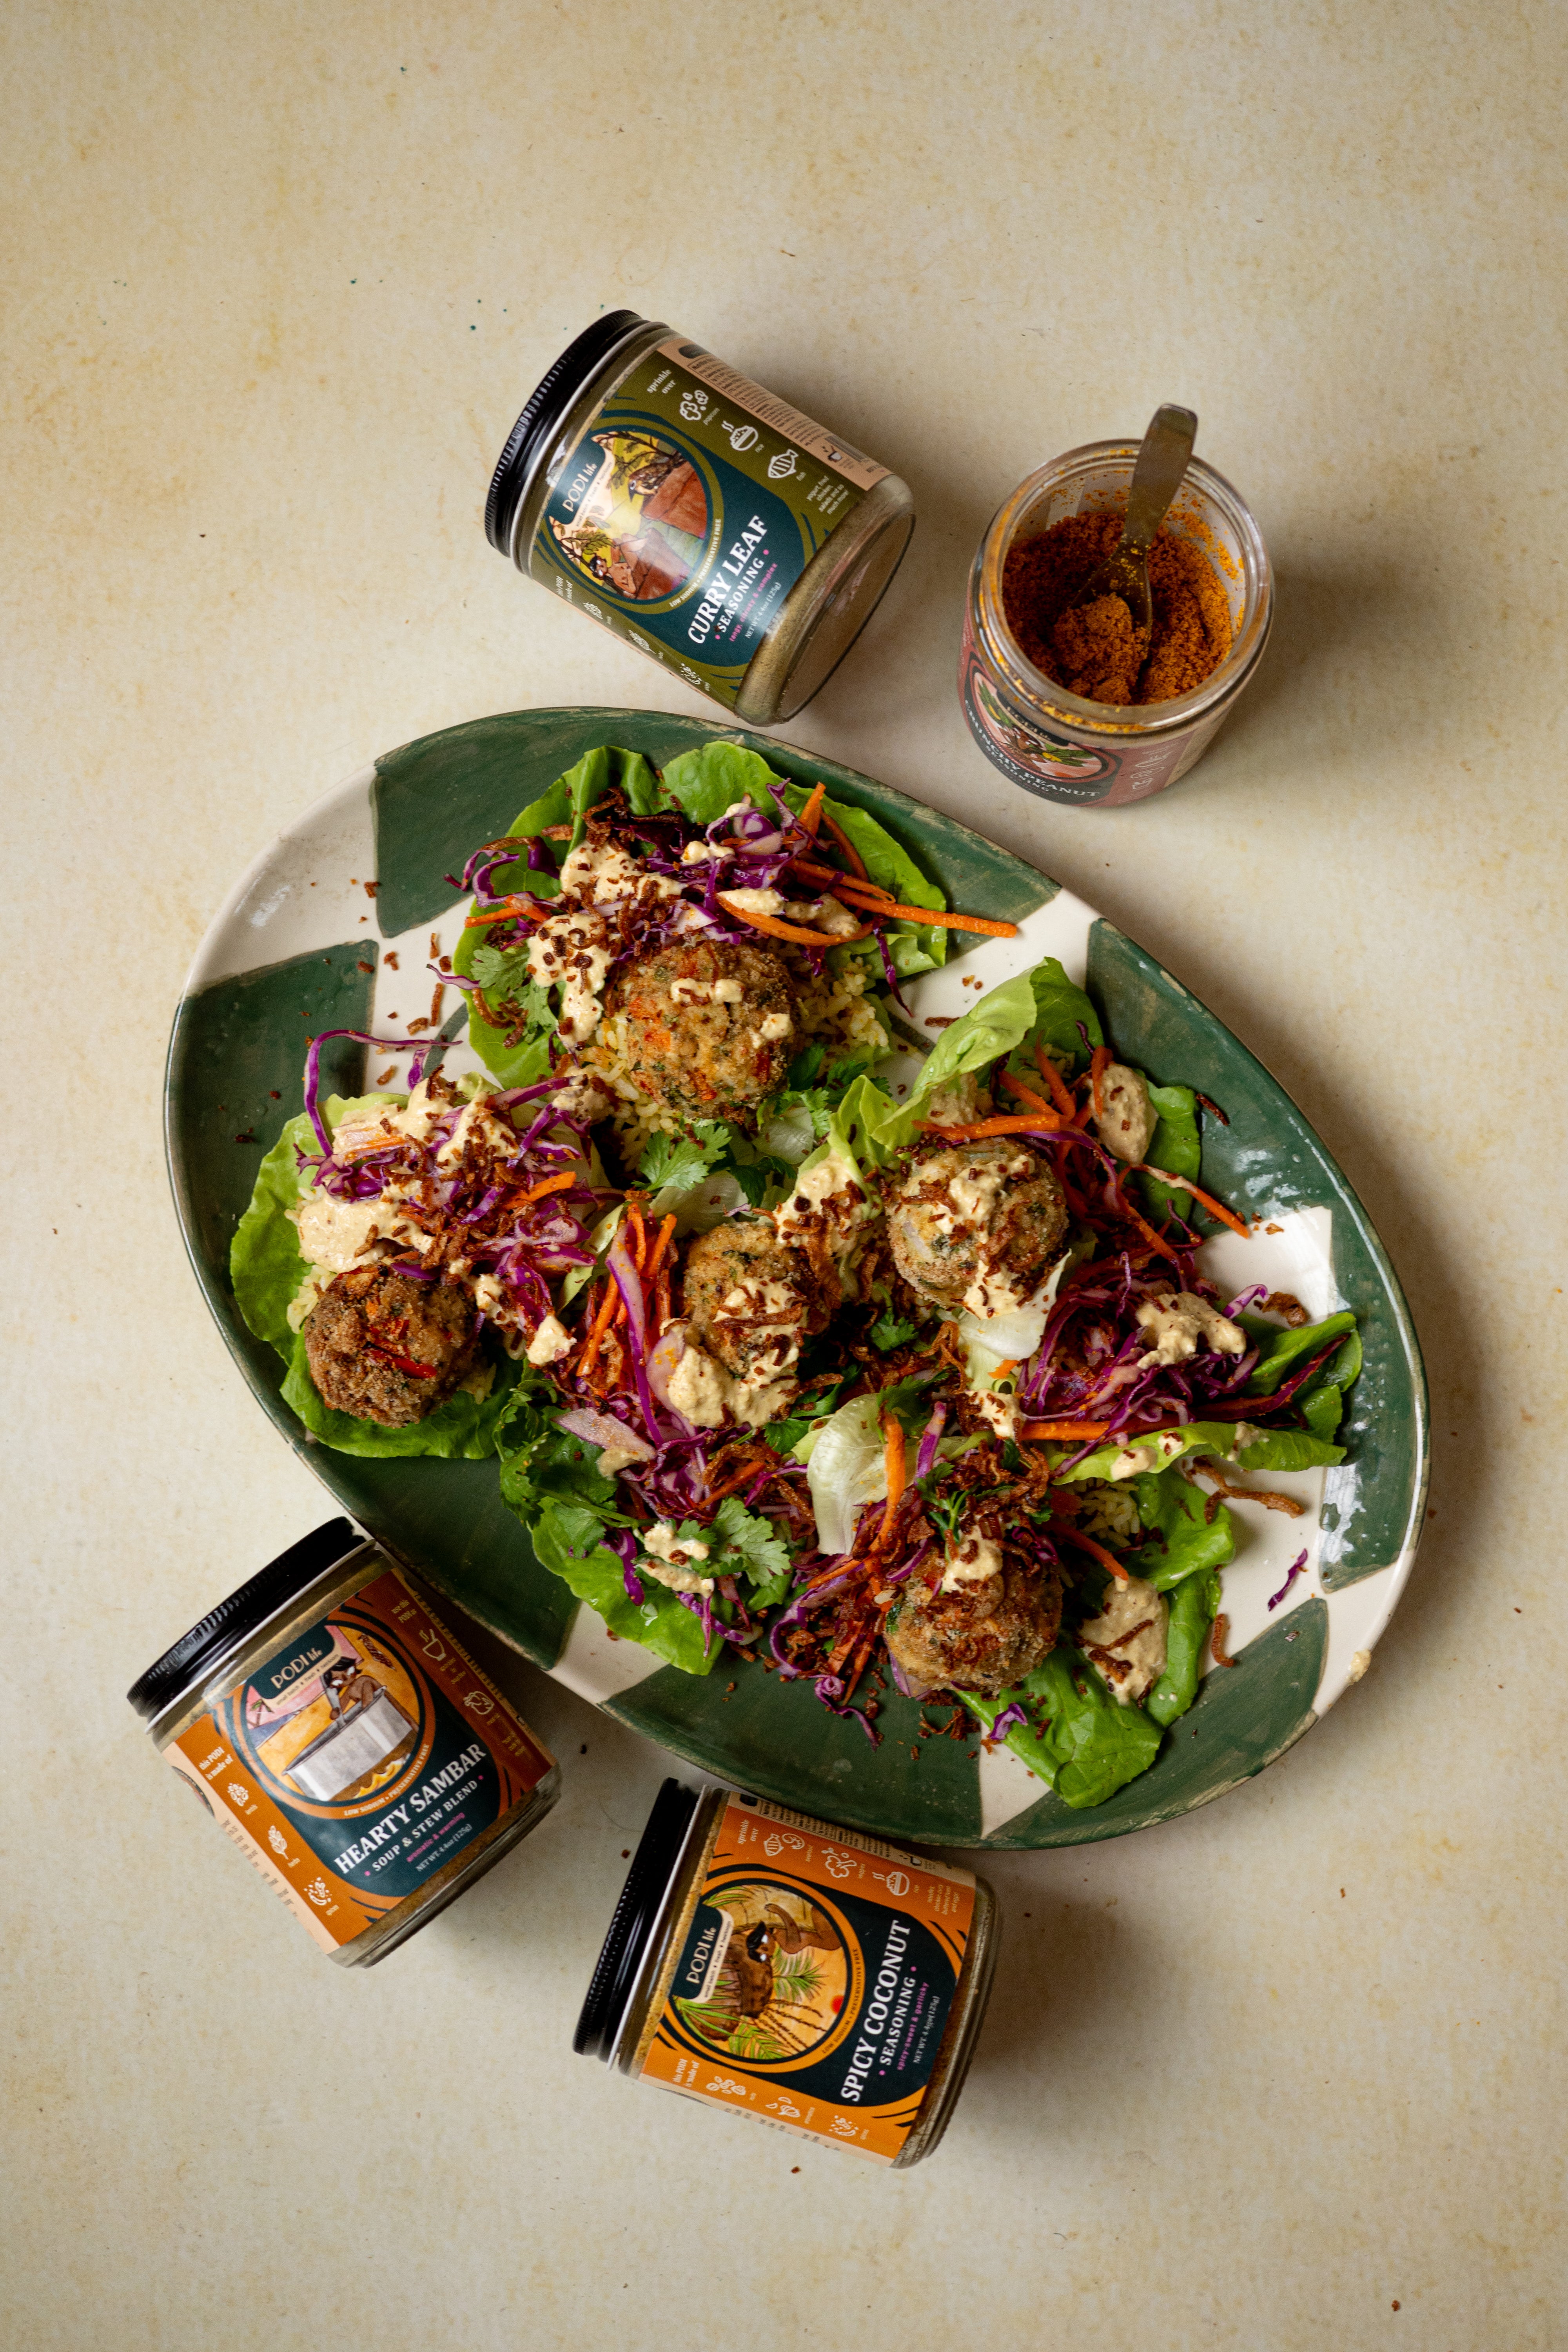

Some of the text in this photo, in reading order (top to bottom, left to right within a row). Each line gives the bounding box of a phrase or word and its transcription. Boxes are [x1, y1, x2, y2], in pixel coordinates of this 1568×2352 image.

[646, 369, 671, 393] sprinkle
[661, 379, 676, 394] over
[702, 407, 720, 425] popcorn
[755, 443, 764, 453] rice
[562, 463, 597, 512] PODI life
[826, 500, 840, 515] much
[829, 488, 840, 498] and
[565, 580, 573, 589] of
[669, 598, 682, 607] LOW
[680, 582, 698, 601] SODIUM
[698, 535, 719, 580] PRESERVATIVE
[687, 514, 768, 643] CURRY LEAF
[716, 557, 765, 633] SEASONING
[729, 623, 742, 642] tangy,
[757, 562, 778, 592] complex
[745, 625, 755, 639] NET
[766, 581, 782, 602] (125g)
[965, 699, 1021, 770] CRUNCHY
[1024, 772, 1100, 797] PEANUT
[398, 1610, 412, 1623] PODI
[270, 1647, 323, 1689] PODI life
[198, 1746, 225, 1770] this PODI
[210, 1761, 227, 1777] made
[224, 1754, 233, 1765] of
[343, 1744, 430, 1816] LOW SODIUM PRESERVATIVE FREE
[333, 1802, 412, 1875] HEARTY
[408, 1743, 486, 1814] SAMBAR
[371, 1779, 479, 1871] SOUP & STEW BLEND
[405, 1811, 466, 1863] aromatic & warming
[415, 1858, 429, 1872] NET
[452, 1823, 473, 1842] (125g)
[737, 1819, 750, 1844] sprinkle
[750, 1827, 759, 1841] over
[685, 1927, 717, 1984] PODI life
[707, 1969, 715, 1984] batch
[840, 1920, 911, 2102] SPICY COCONUT
[879, 1976, 916, 2066] SEASONING
[897, 2023, 916, 2071] spicy-sweet
[915, 1982, 929, 2014] garlicky
[673, 2058, 688, 2082] this PODI
[691, 2060, 699, 2069] of
[913, 2050, 923, 2064] NET
